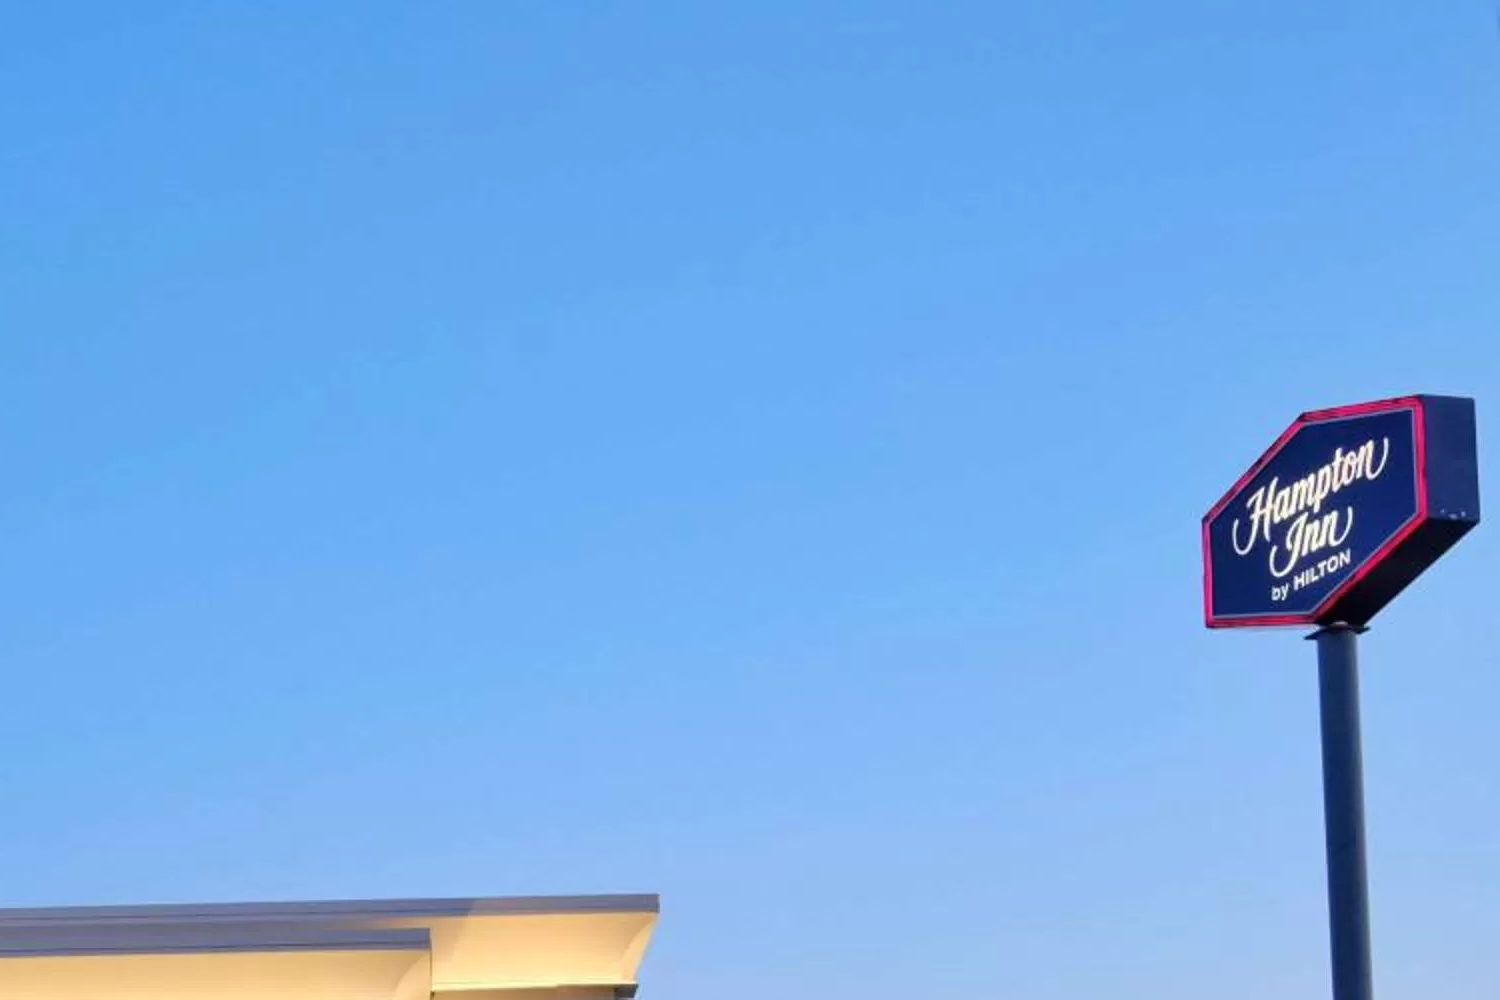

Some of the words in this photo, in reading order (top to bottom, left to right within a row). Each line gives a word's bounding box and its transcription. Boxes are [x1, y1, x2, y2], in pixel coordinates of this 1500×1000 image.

[1233, 437, 1389, 555] Hampton
[1269, 506, 1353, 577] Inn
[1271, 584, 1289, 601] by
[1293, 549, 1351, 590] HILTON
